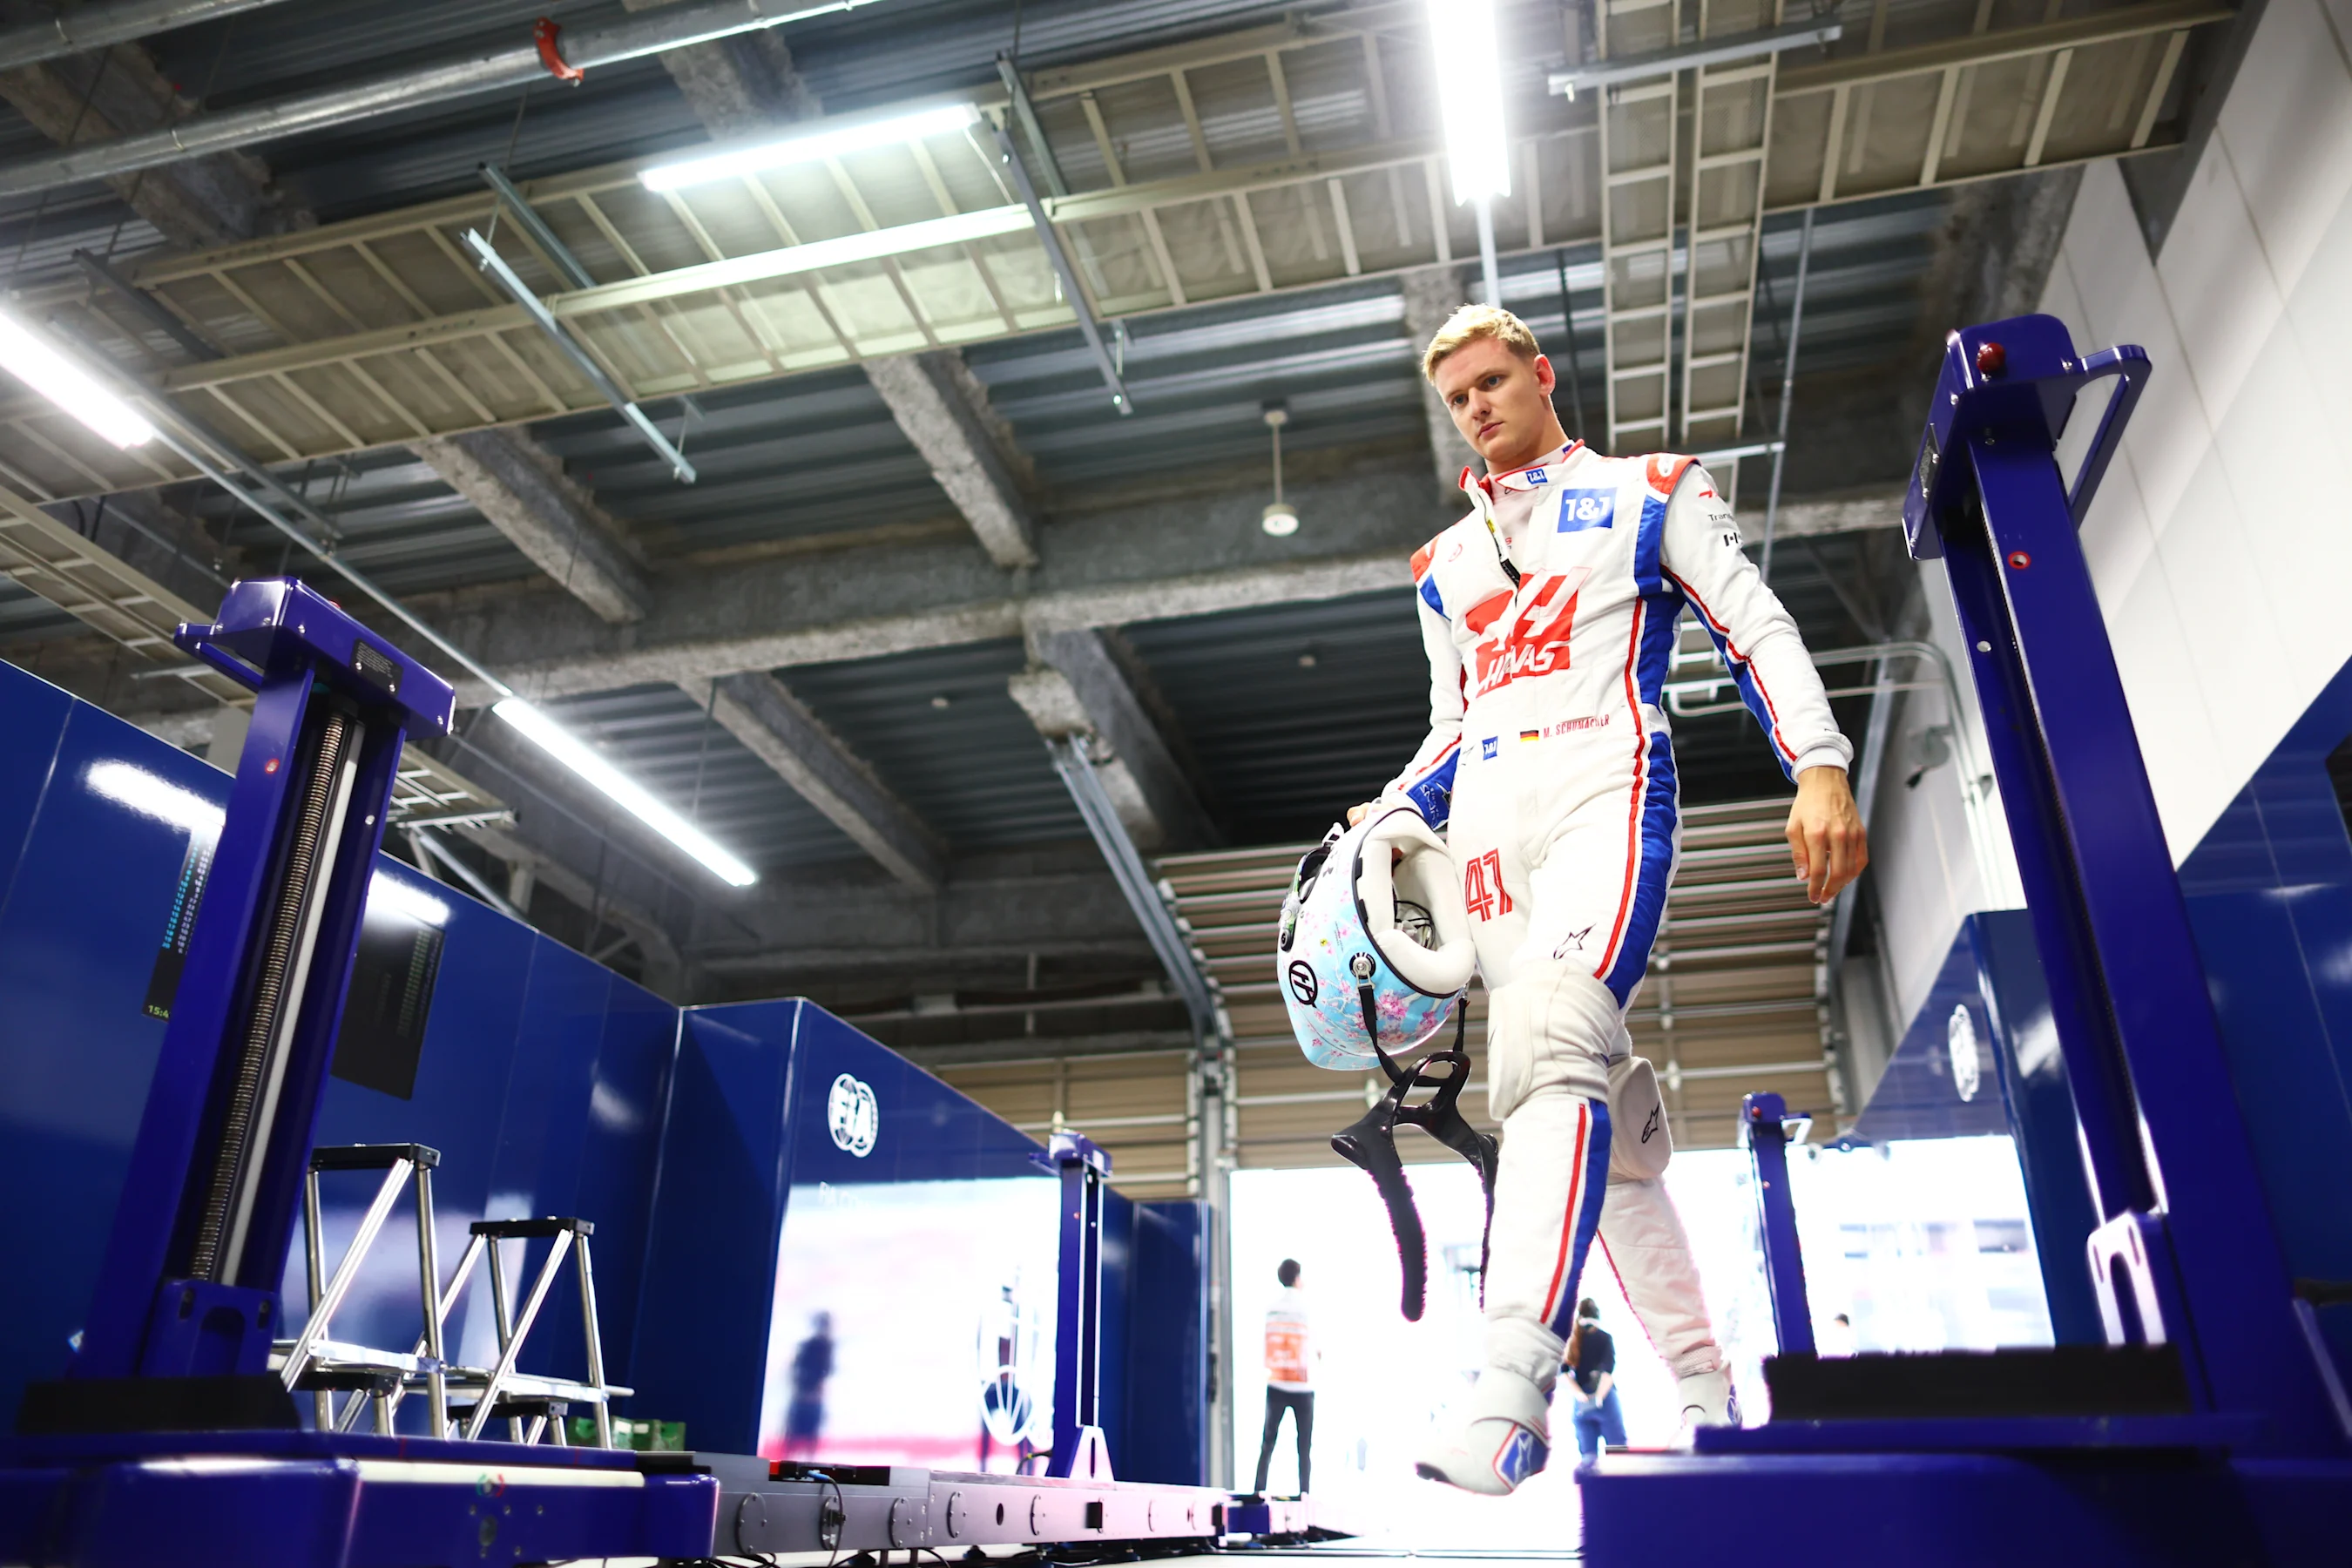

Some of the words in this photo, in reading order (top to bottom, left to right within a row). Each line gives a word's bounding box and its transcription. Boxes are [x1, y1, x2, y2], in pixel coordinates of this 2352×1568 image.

[1527, 471, 1545, 483] 1&1
[1565, 496, 1611, 522] 1&1
[1478, 640, 1569, 692] HAAS
[1544, 727, 1553, 740] M.
